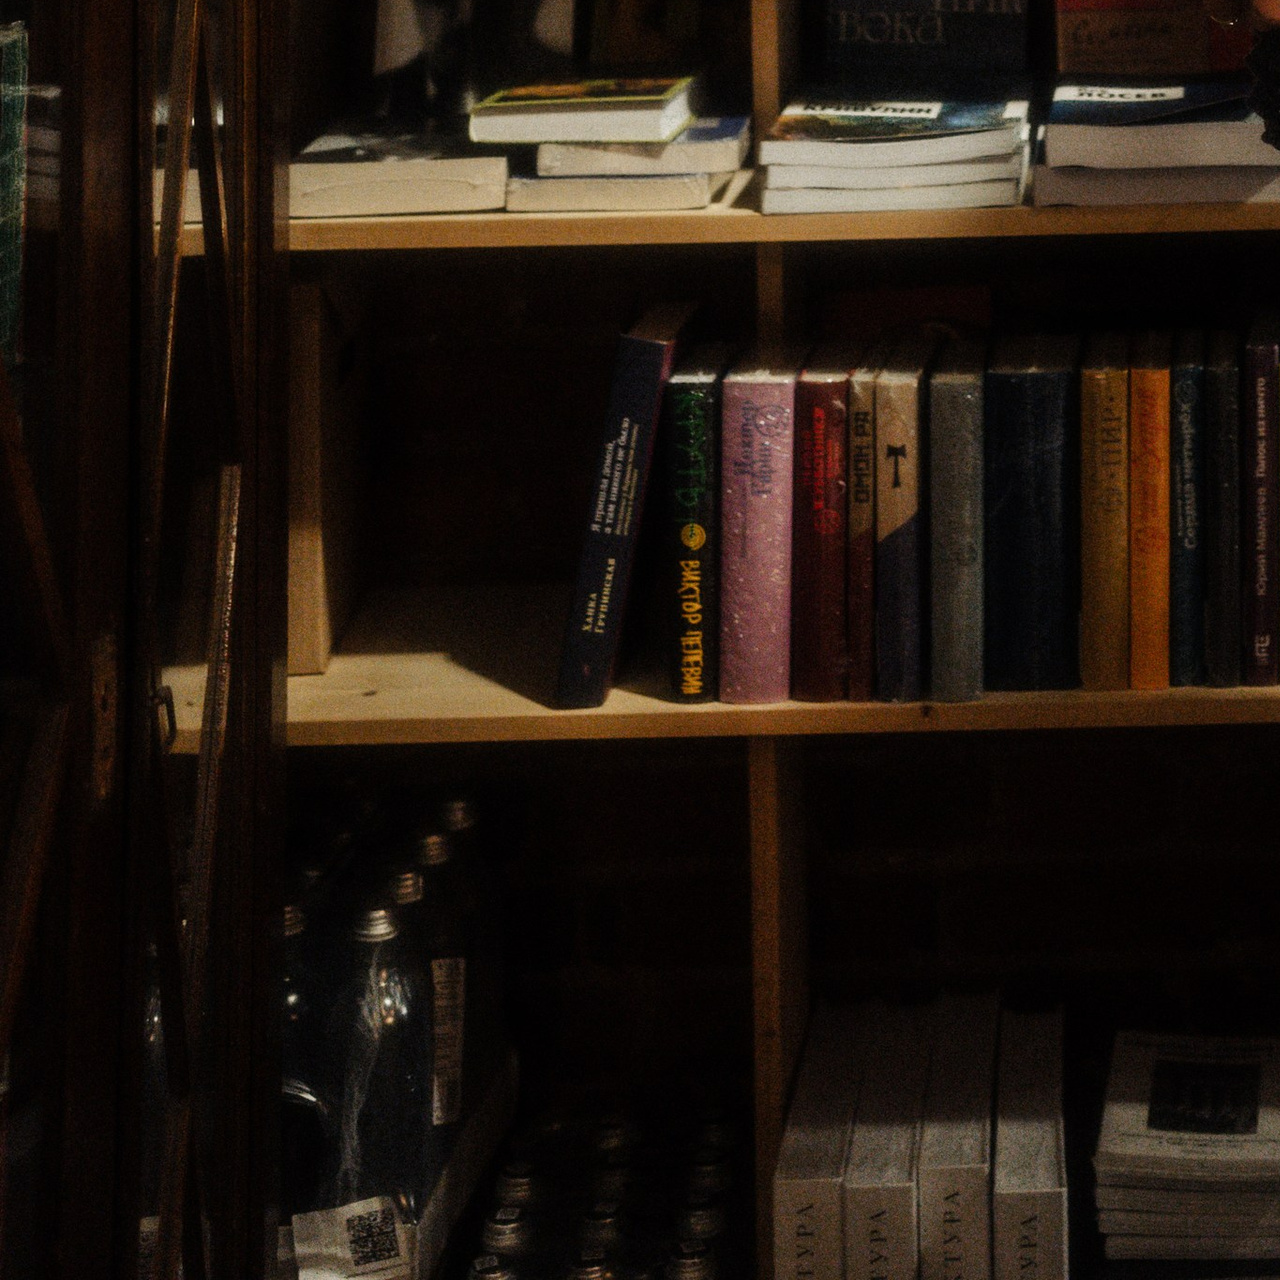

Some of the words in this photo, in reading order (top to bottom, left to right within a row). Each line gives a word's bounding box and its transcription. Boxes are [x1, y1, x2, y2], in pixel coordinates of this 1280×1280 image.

[852, 411, 871, 439] РА
[1098, 405, 1122, 468] ПИР
[594, 477, 611, 522] пришла
[852, 444, 871, 505] ОМОН
[1182, 482, 1199, 551] Сердца
[1255, 487, 1267, 552] Мамлеев
[594, 557, 617, 635] ГРУПИНСКАЯ
[678, 559, 704, 624] ВИКТОР
[1256, 554, 1269, 596] Юрий
[581, 592, 598, 633] ХАНКА
[680, 629, 704, 695] ПЕЛЕВИН
